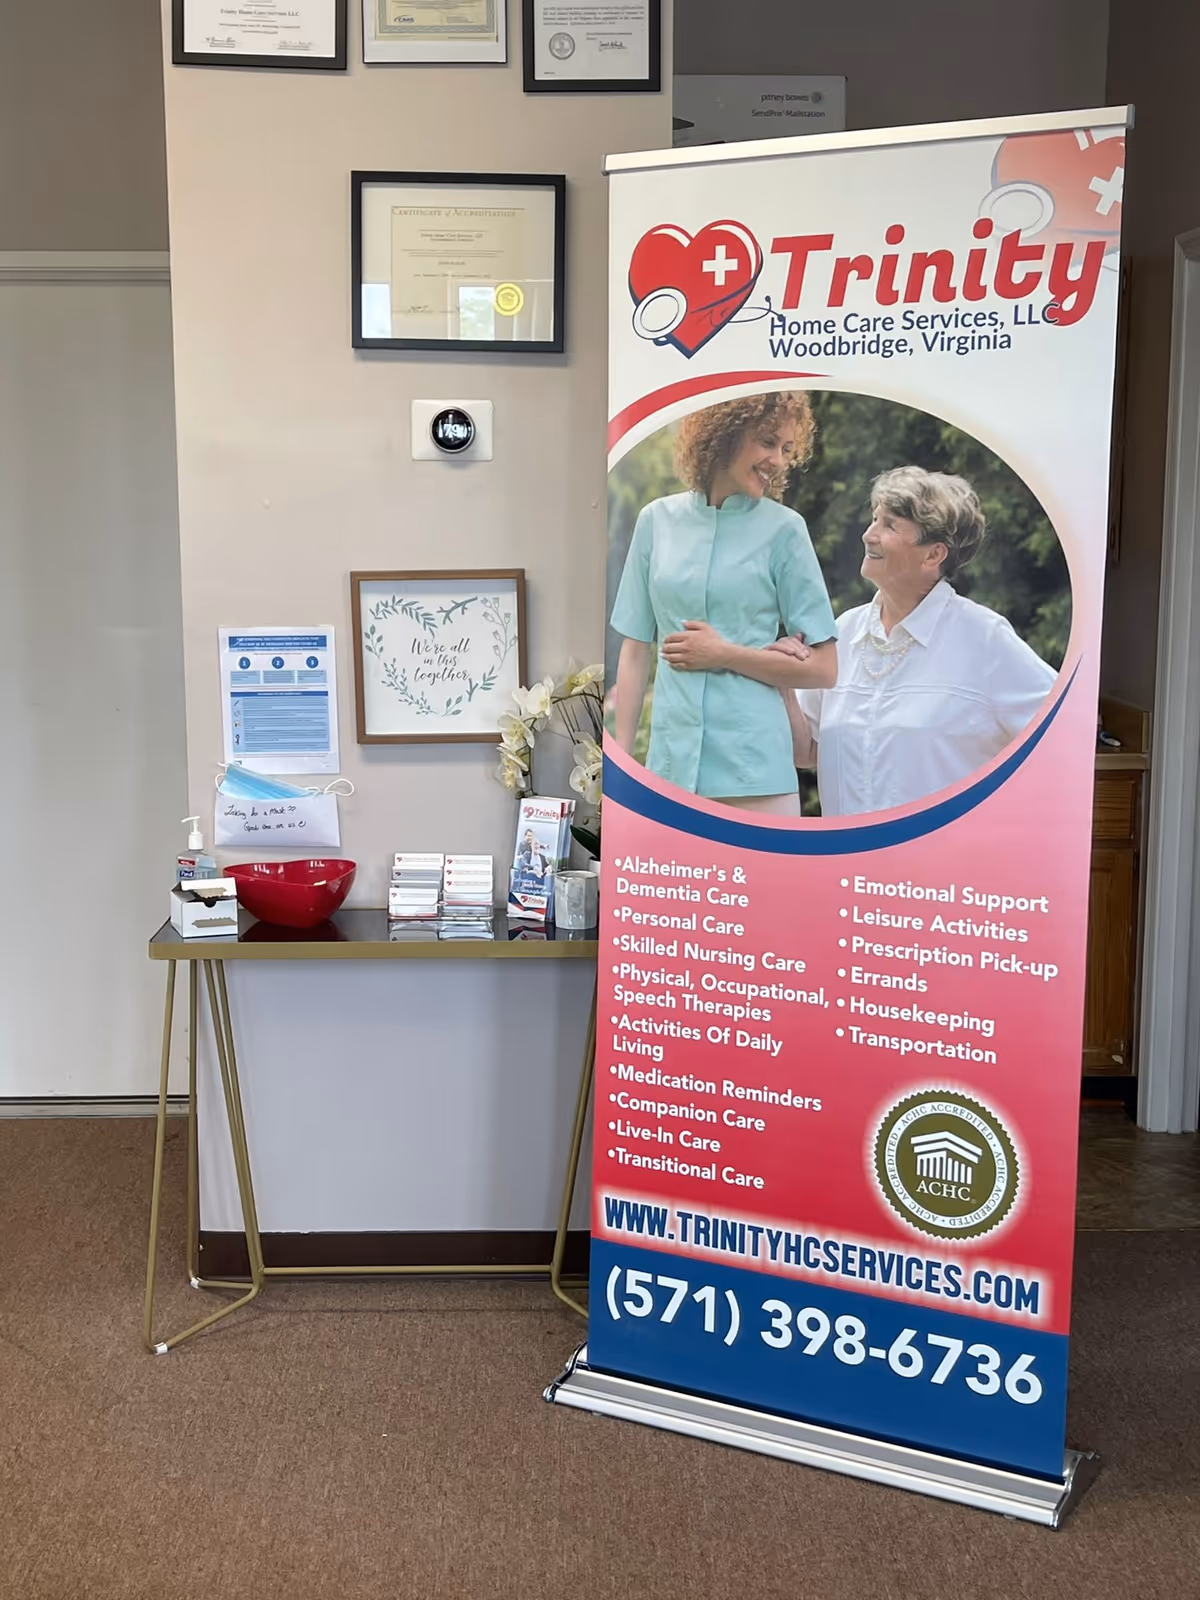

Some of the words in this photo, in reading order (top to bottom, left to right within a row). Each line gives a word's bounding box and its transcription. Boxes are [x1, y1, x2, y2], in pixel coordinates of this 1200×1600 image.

[770, 217, 1107, 326] Trinity
[770, 316, 836, 337] Home
[843, 312, 895, 334] Care
[901, 308, 1004, 330] Services,
[1013, 302, 1060, 326] LLC
[769, 334, 914, 358] Woodbridge,
[921, 329, 1012, 355] Virginia
[412, 638, 446, 655] We're
[450, 638, 470, 653] all
[437, 654, 457, 666] this
[414, 667, 469, 686] together
[622, 856, 727, 882] Alzheimer's
[732, 867, 747, 884] &
[616, 878, 701, 902] Dementia
[707, 887, 749, 907] Care
[853, 875, 955, 903] Emotional
[962, 887, 1049, 913] Support
[621, 907, 697, 930] Personal
[703, 916, 745, 936] Care
[853, 906, 924, 930] Leisure
[929, 915, 1028, 943] Activities
[620, 935, 678, 957] Skilled
[684, 943, 755, 971] Nursing
[762, 952, 806, 973] Care
[852, 936, 973, 966] Prescription
[980, 952, 1059, 982] Pick-up
[620, 963, 694, 990] Physical,
[701, 973, 830, 1008] Occupational,
[851, 966, 928, 992] Errands
[614, 985, 676, 1008] Speech
[682, 994, 771, 1022] Therapies
[850, 996, 995, 1037] Housekeeping
[613, 1034, 663, 1061] Living
[618, 1014, 701, 1040] Activities
[707, 1026, 730, 1044] Of
[736, 1030, 782, 1056] Daily
[848, 1026, 997, 1064] Transportation
[617, 1063, 717, 1094] Medication
[722, 1080, 822, 1112] Reminders
[617, 1092, 717, 1123] Companion
[723, 1109, 765, 1131] Care
[901, 1106, 927, 1127] ACHC
[930, 1104, 994, 1141] ACCREDITED
[617, 1120, 674, 1144] Live-In
[679, 1131, 721, 1152] Care
[615, 1147, 716, 1180] Transitional
[722, 1167, 765, 1189] Care
[916, 1180, 971, 1201] ACHC
[604, 1196, 1040, 1315] WWW.TRINITYHCSERVICES.COM
[605, 1264, 741, 1347] (571)
[759, 1298, 1043, 1405] 398-6736
